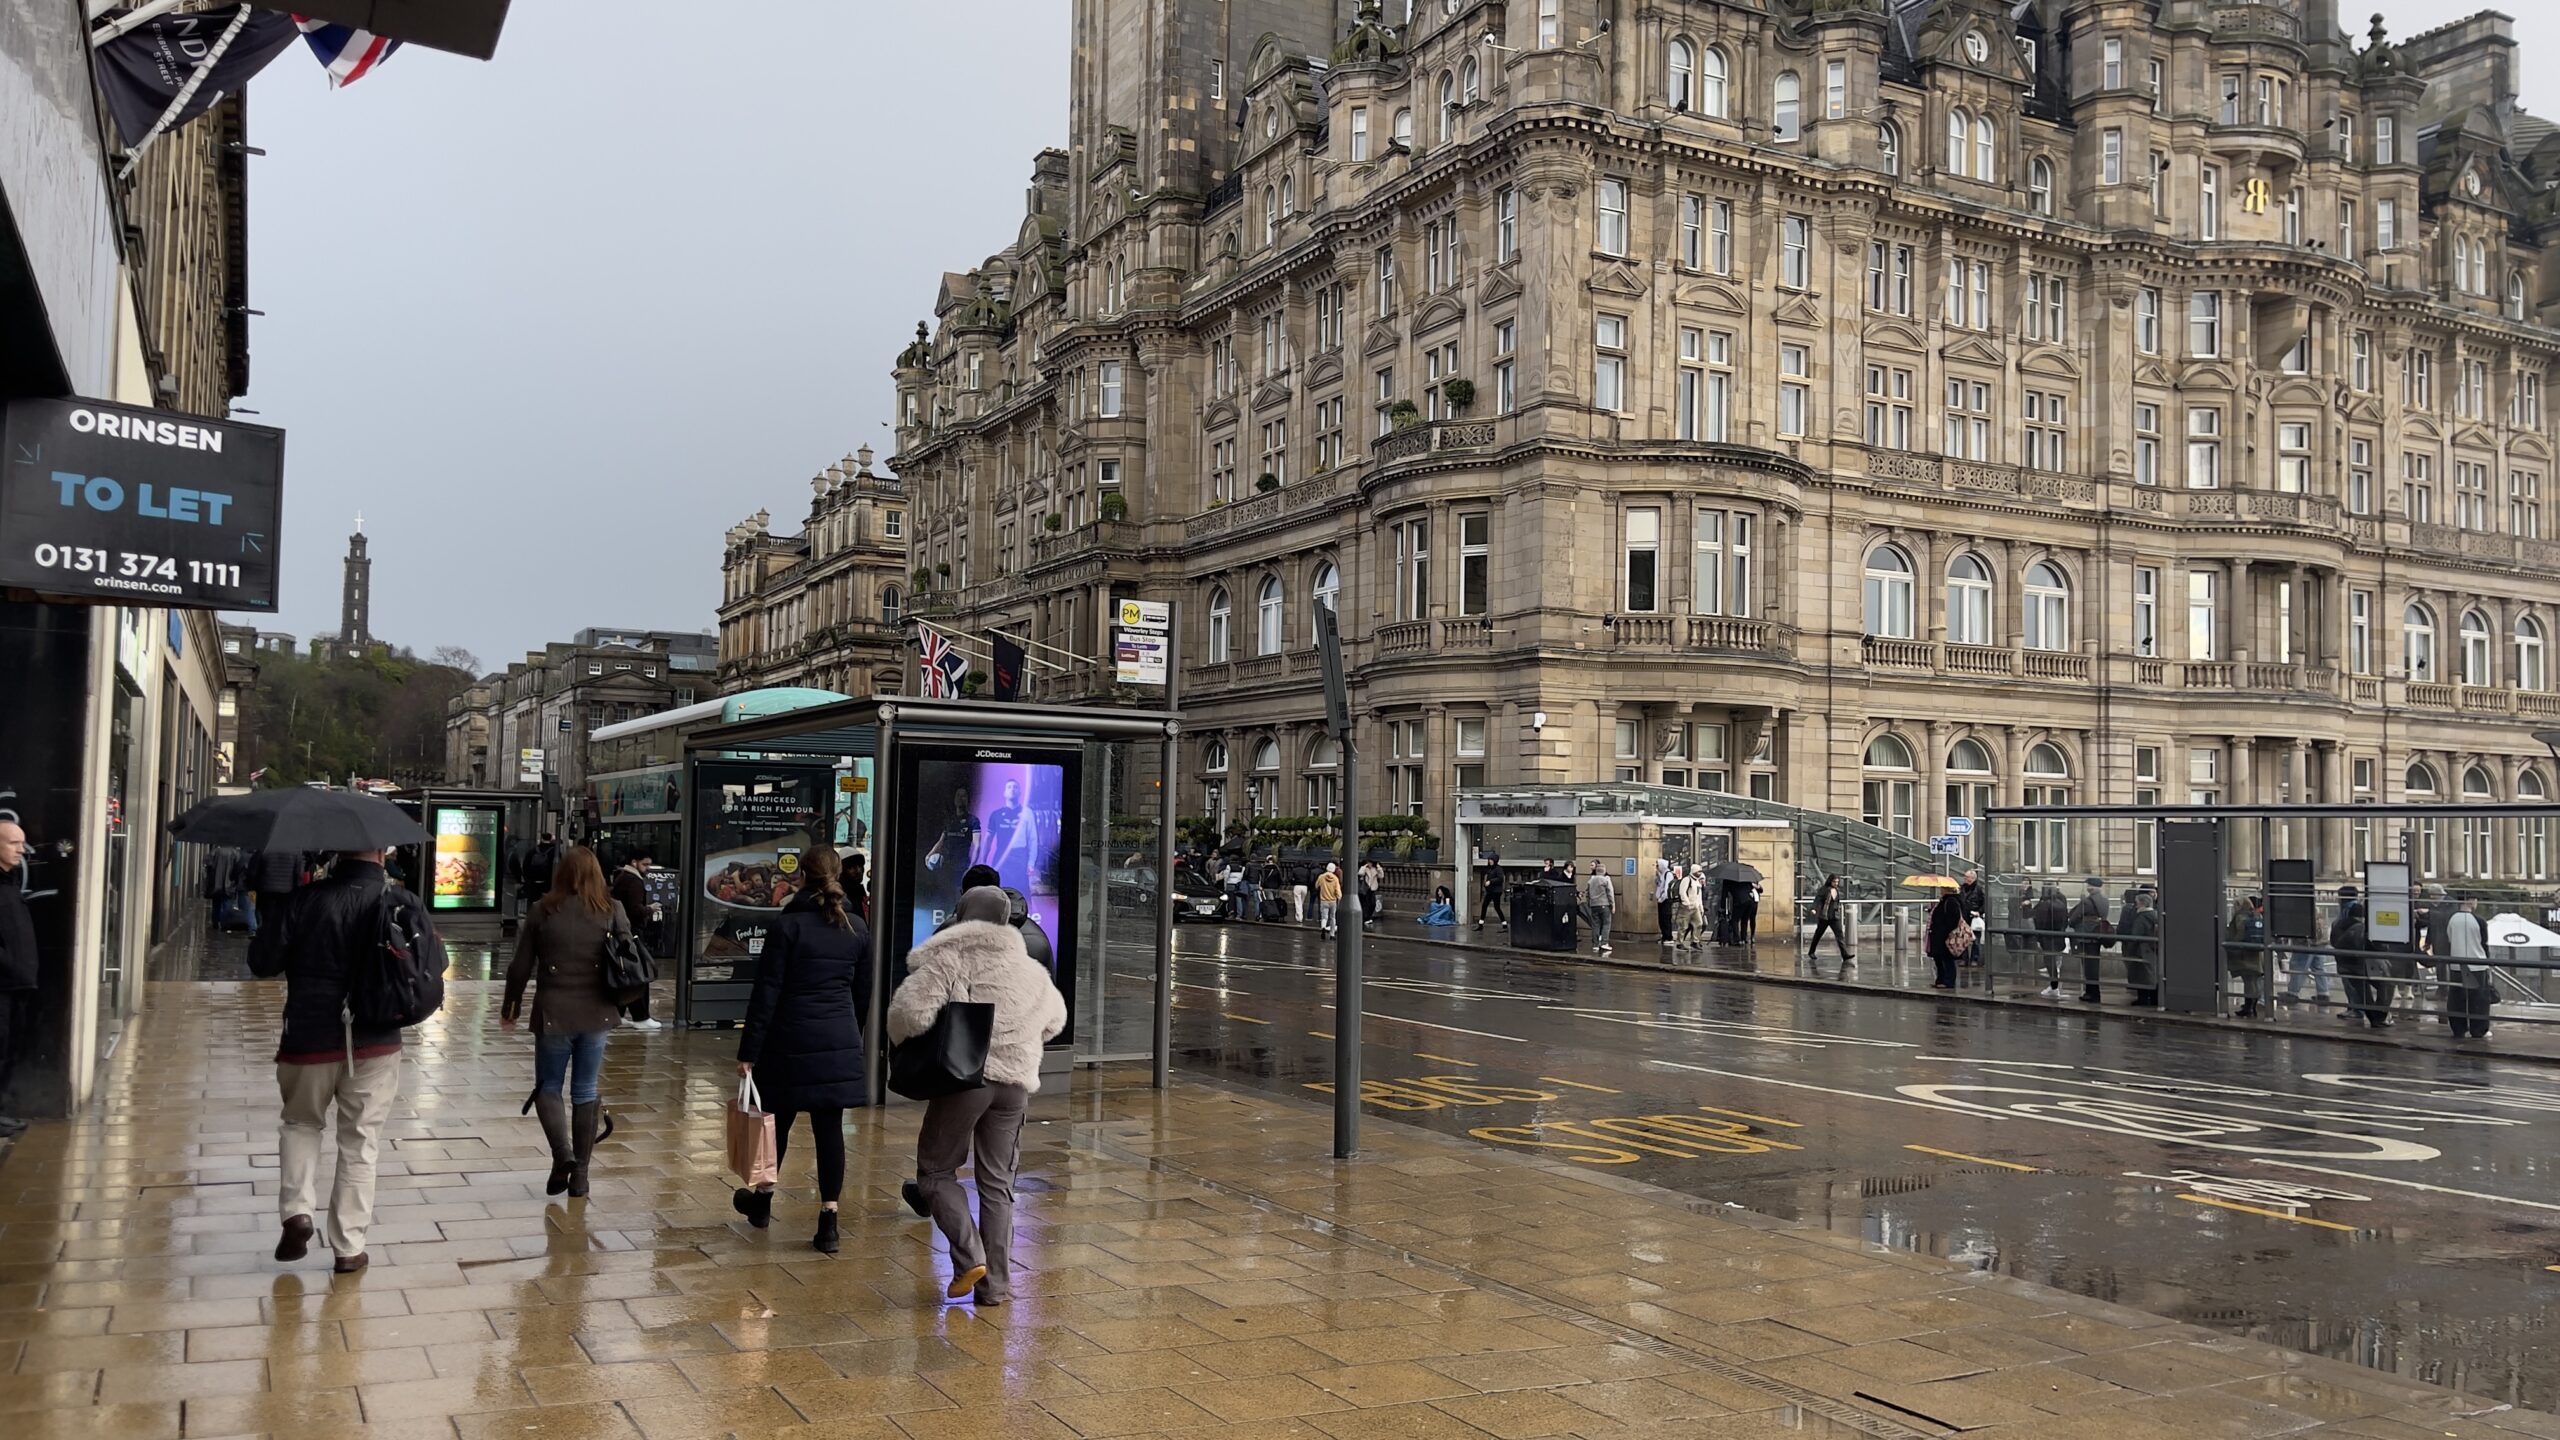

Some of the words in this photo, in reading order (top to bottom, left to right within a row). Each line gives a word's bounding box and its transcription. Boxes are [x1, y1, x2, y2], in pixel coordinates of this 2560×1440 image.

[153, 51, 174, 86] STREET
[70, 409, 222, 453] ORINSEN
[51, 471, 124, 511] TO
[138, 483, 233, 525] LET
[34, 543, 108, 573] 0131
[119, 552, 178, 580] 374
[188, 561, 241, 587] 1111
[94, 576, 182, 595] orinsen.com
[1122, 608, 1140, 619] PM
[1123, 627, 1148, 635] Waverley
[975, 750, 1012, 758] JCDecaux
[722, 804, 739, 812] FOR
[740, 796, 796, 804] HANDPICKED
[736, 926, 753, 941] Food
[1301, 1076, 1558, 1110] BUS
[1469, 1114, 1804, 1165] STOP
